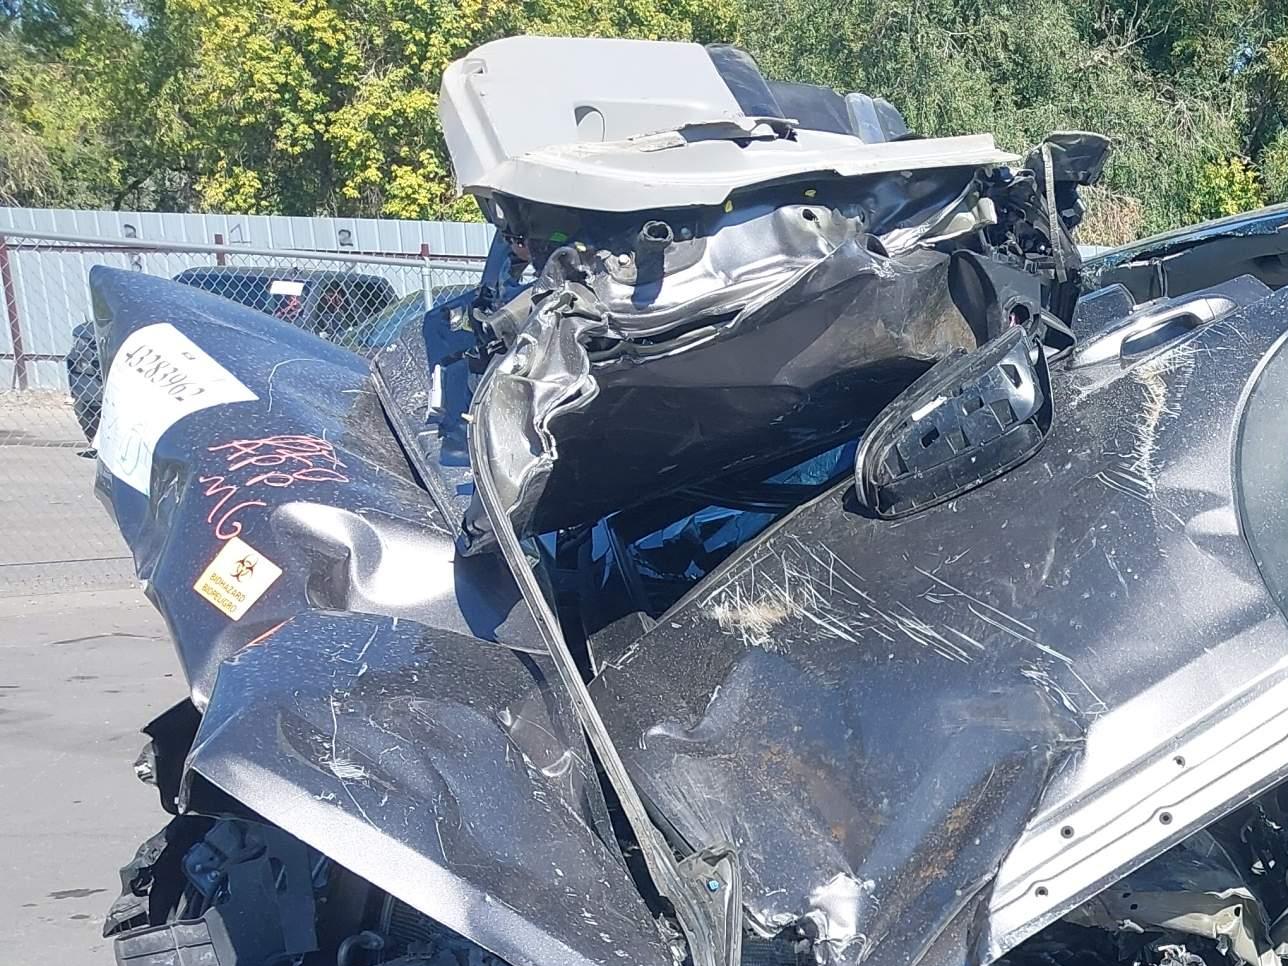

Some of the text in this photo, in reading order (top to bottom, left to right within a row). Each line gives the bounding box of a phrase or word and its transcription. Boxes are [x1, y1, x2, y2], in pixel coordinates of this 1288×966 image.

[124, 344, 205, 402] 43283962
[201, 583, 238, 612] BIOPELIGRO
[210, 573, 246, 602] BIOHAZARD
